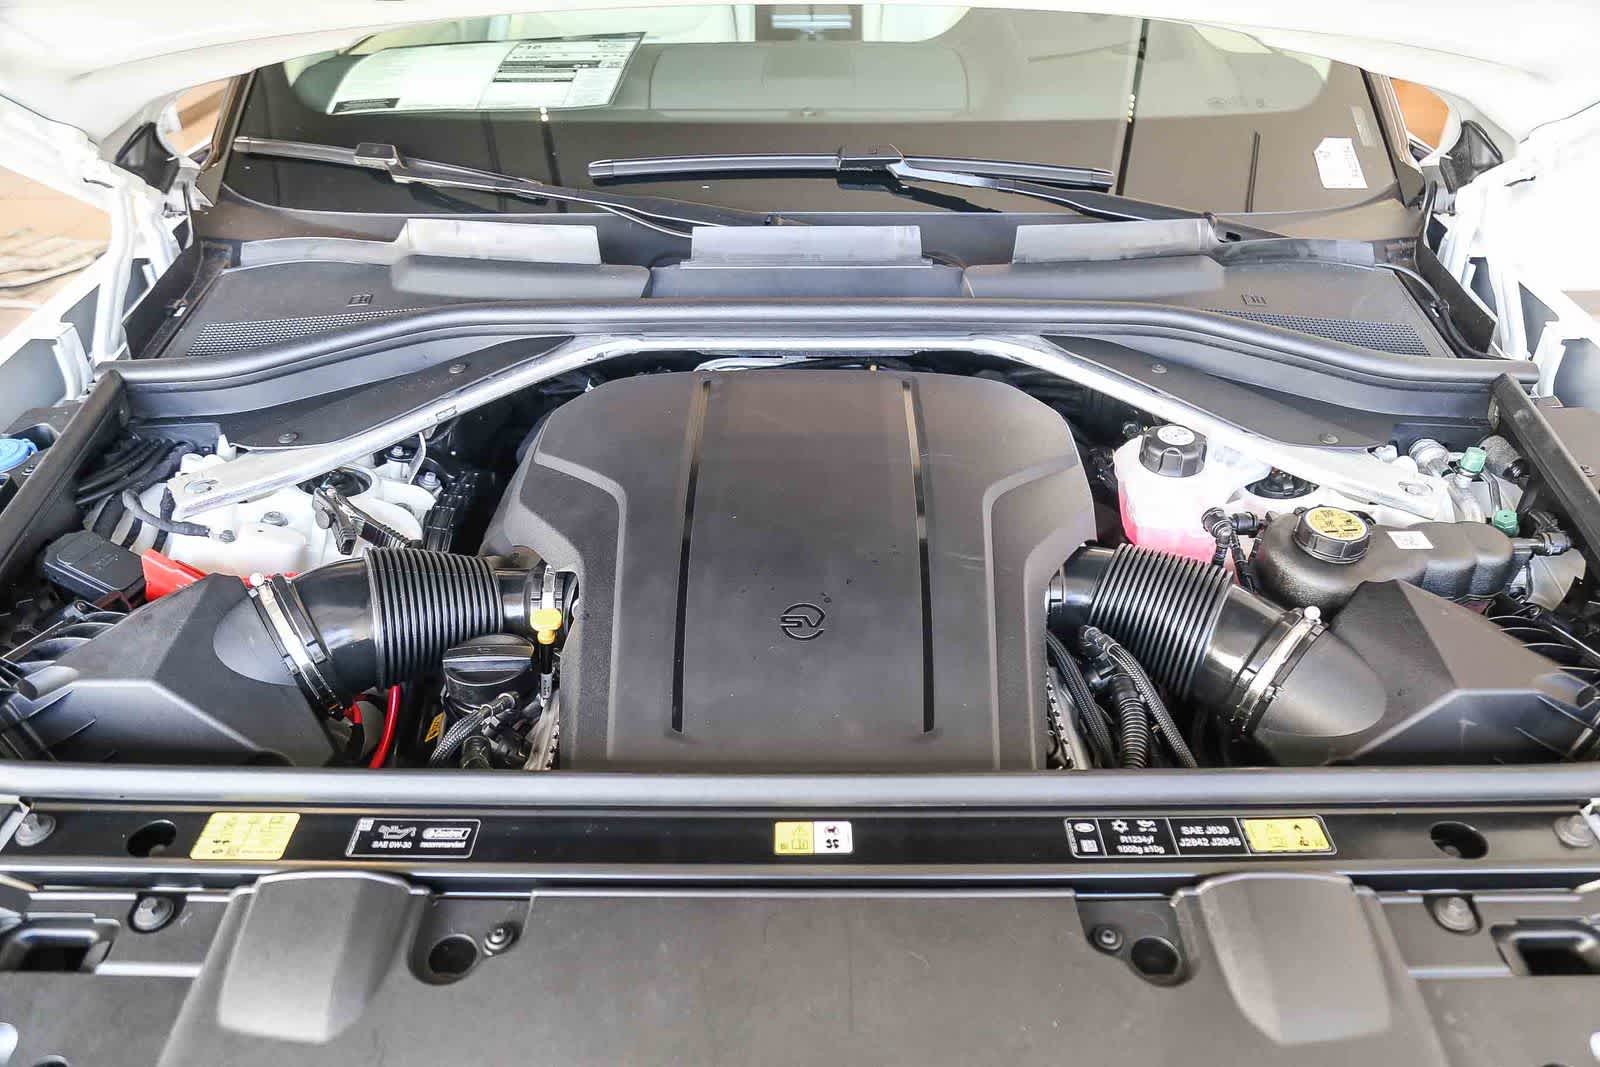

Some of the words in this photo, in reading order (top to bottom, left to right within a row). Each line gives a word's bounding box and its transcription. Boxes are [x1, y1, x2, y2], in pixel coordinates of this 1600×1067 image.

[1180, 826, 1204, 835] SAE
[371, 840, 388, 848] SAE
[1119, 835, 1155, 845] R1234yf
